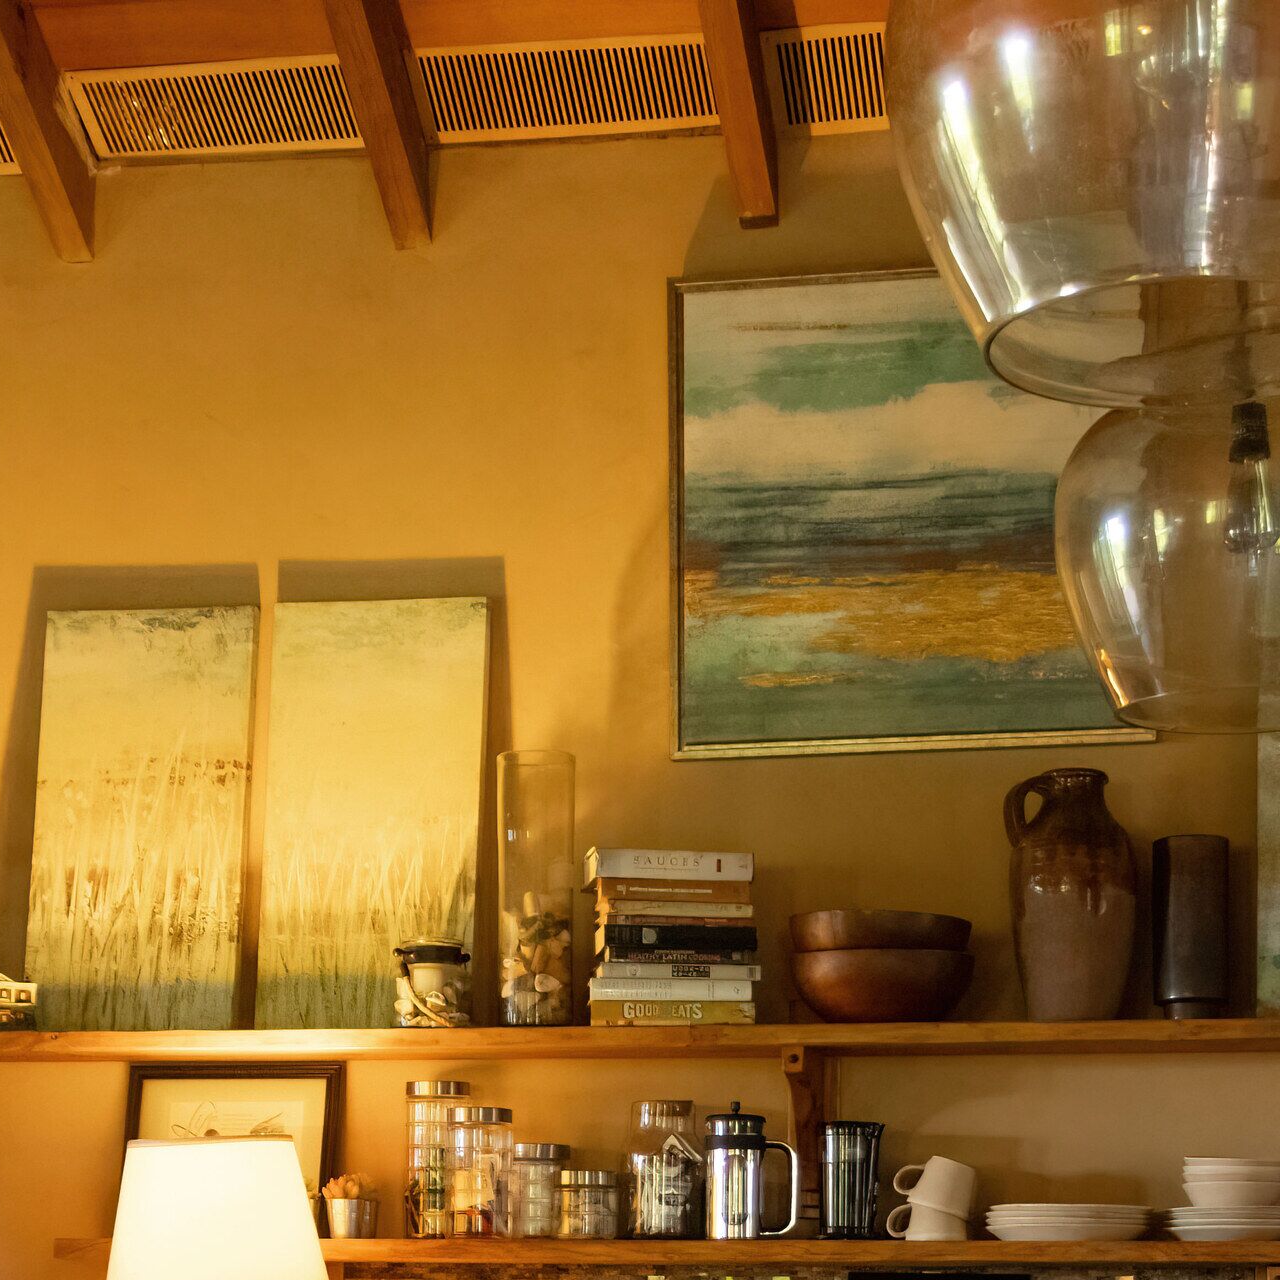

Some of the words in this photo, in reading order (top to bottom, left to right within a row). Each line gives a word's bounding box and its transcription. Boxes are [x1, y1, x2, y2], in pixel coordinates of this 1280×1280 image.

[632, 854, 702, 867] SAUCES
[662, 953, 688, 961] LATIN
[623, 1002, 660, 1019] GOOD
[671, 1003, 703, 1019] EATS
